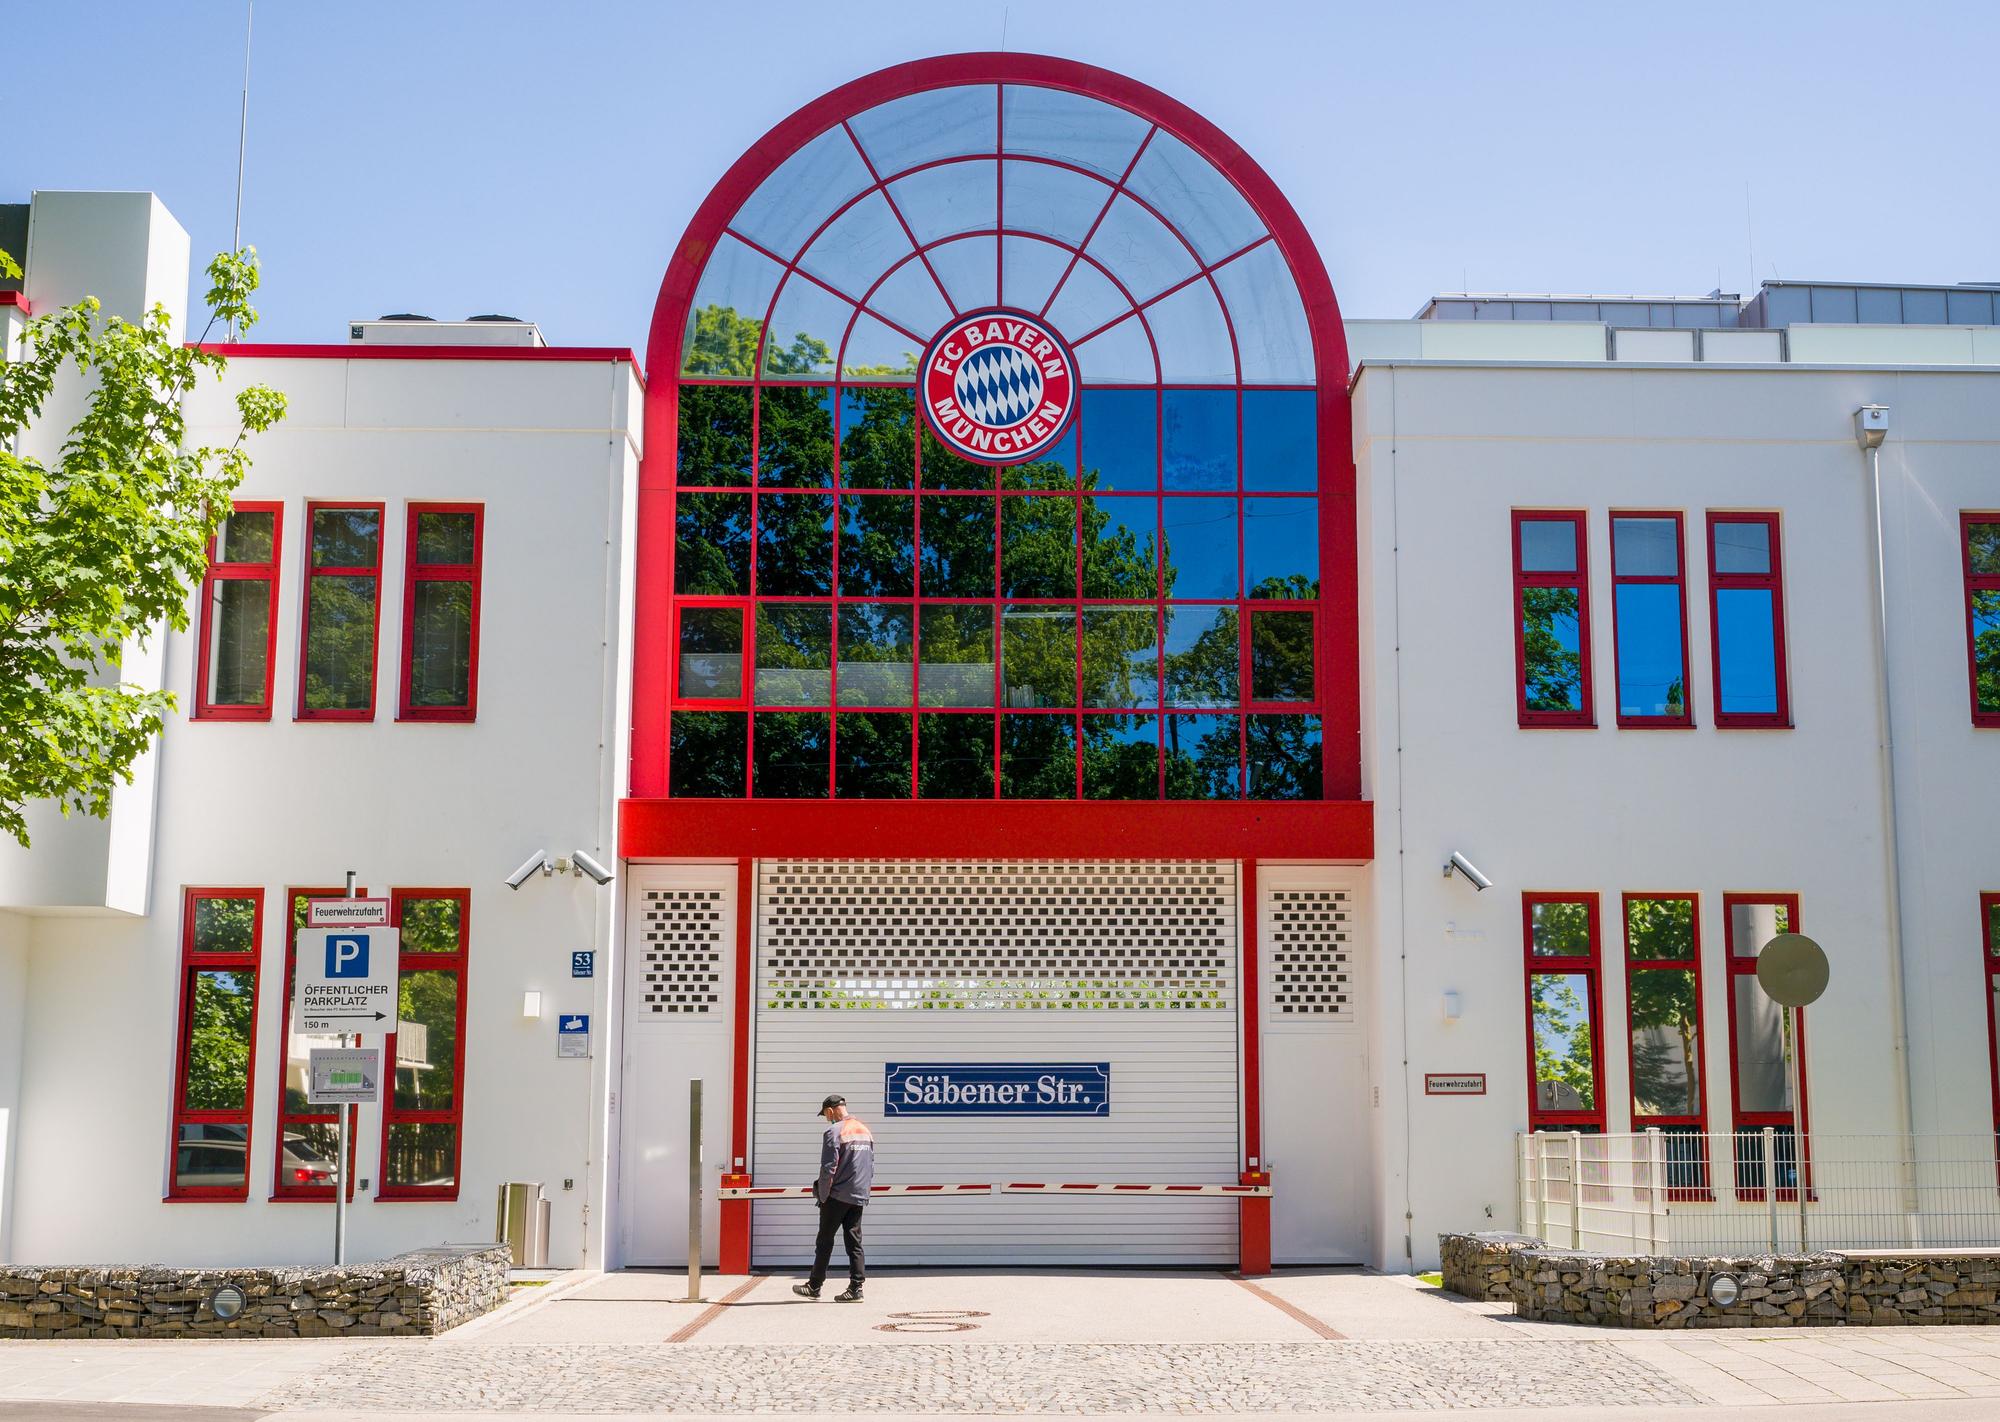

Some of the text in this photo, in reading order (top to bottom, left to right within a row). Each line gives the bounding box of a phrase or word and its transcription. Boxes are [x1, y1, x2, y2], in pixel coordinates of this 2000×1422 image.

[934, 321, 1065, 379] FC BAYERN
[934, 396, 1063, 452] MÜNCHEN
[315, 907, 383, 916] Feuerwehrzufahrt
[335, 940, 360, 973] P
[575, 953, 591, 965] 53
[304, 984, 388, 995] ÖFFENTLICHER
[304, 997, 367, 1005] PARKPLATZ
[904, 1075, 1090, 1104] Säbener Str.
